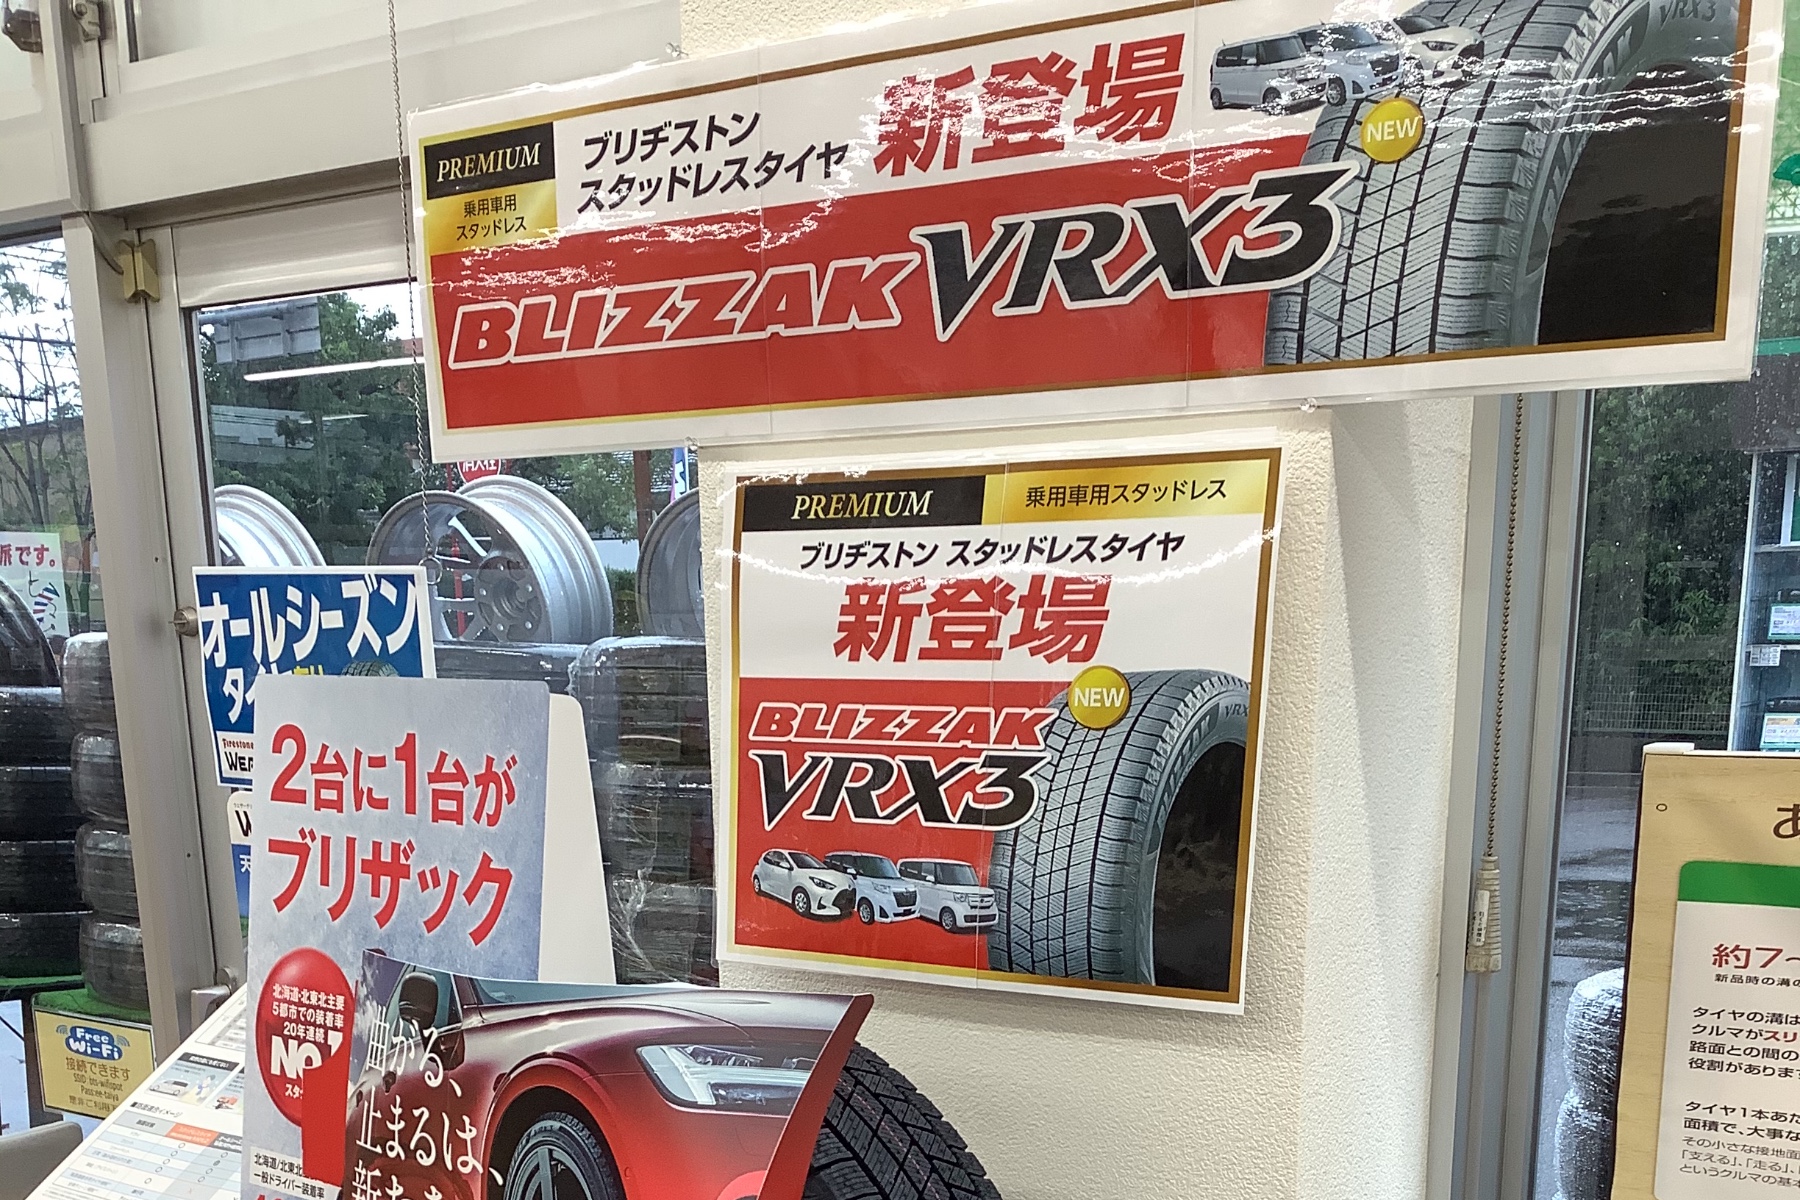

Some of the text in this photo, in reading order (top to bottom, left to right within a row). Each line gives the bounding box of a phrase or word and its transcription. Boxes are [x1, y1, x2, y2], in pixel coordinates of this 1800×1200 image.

[872, 33, 1187, 177] 新登場
[583, 112, 761, 171] ブリヂストン
[1366, 113, 1418, 144] NEW
[436, 142, 541, 183] PREMIUM
[577, 143, 848, 213] スタッドレスタイヤ
[463, 194, 518, 219] 乗用車用
[456, 215, 527, 241] スタッドレス
[448, 161, 1362, 370] BLIZZAK VRX3
[791, 491, 933, 519] PREMIUM
[1026, 479, 1227, 508] 乗用車用スタッドレス
[801, 532, 1184, 570] ブリヂストン スタッドレスタイヤ
[200, 573, 417, 667] オールシーズン
[834, 574, 1113, 664] 新登場
[1074, 687, 1125, 708] NEW
[749, 702, 1059, 750] BLIZZAK
[270, 723, 518, 827] 2台に1台が
[750, 750, 1052, 832] VRX3
[268, 827, 513, 946] ブリザック
[272, 1001, 344, 1028] 5都市での装着率
[69, 1038, 119, 1060] Wi-Fi
[75, 1027, 109, 1043] Free
[284, 1022, 325, 1043] 20年連続
[366, 1005, 462, 1097] 曲がる、
[1688, 1057, 1800, 1079] 役割がありま
[1689, 1041, 1800, 1061] 路面との間の
[66, 1057, 130, 1081] 接続できます
[356, 1095, 504, 1185] 止まるは、
[254, 1173, 325, 1200] 一般ドライバー装着率
